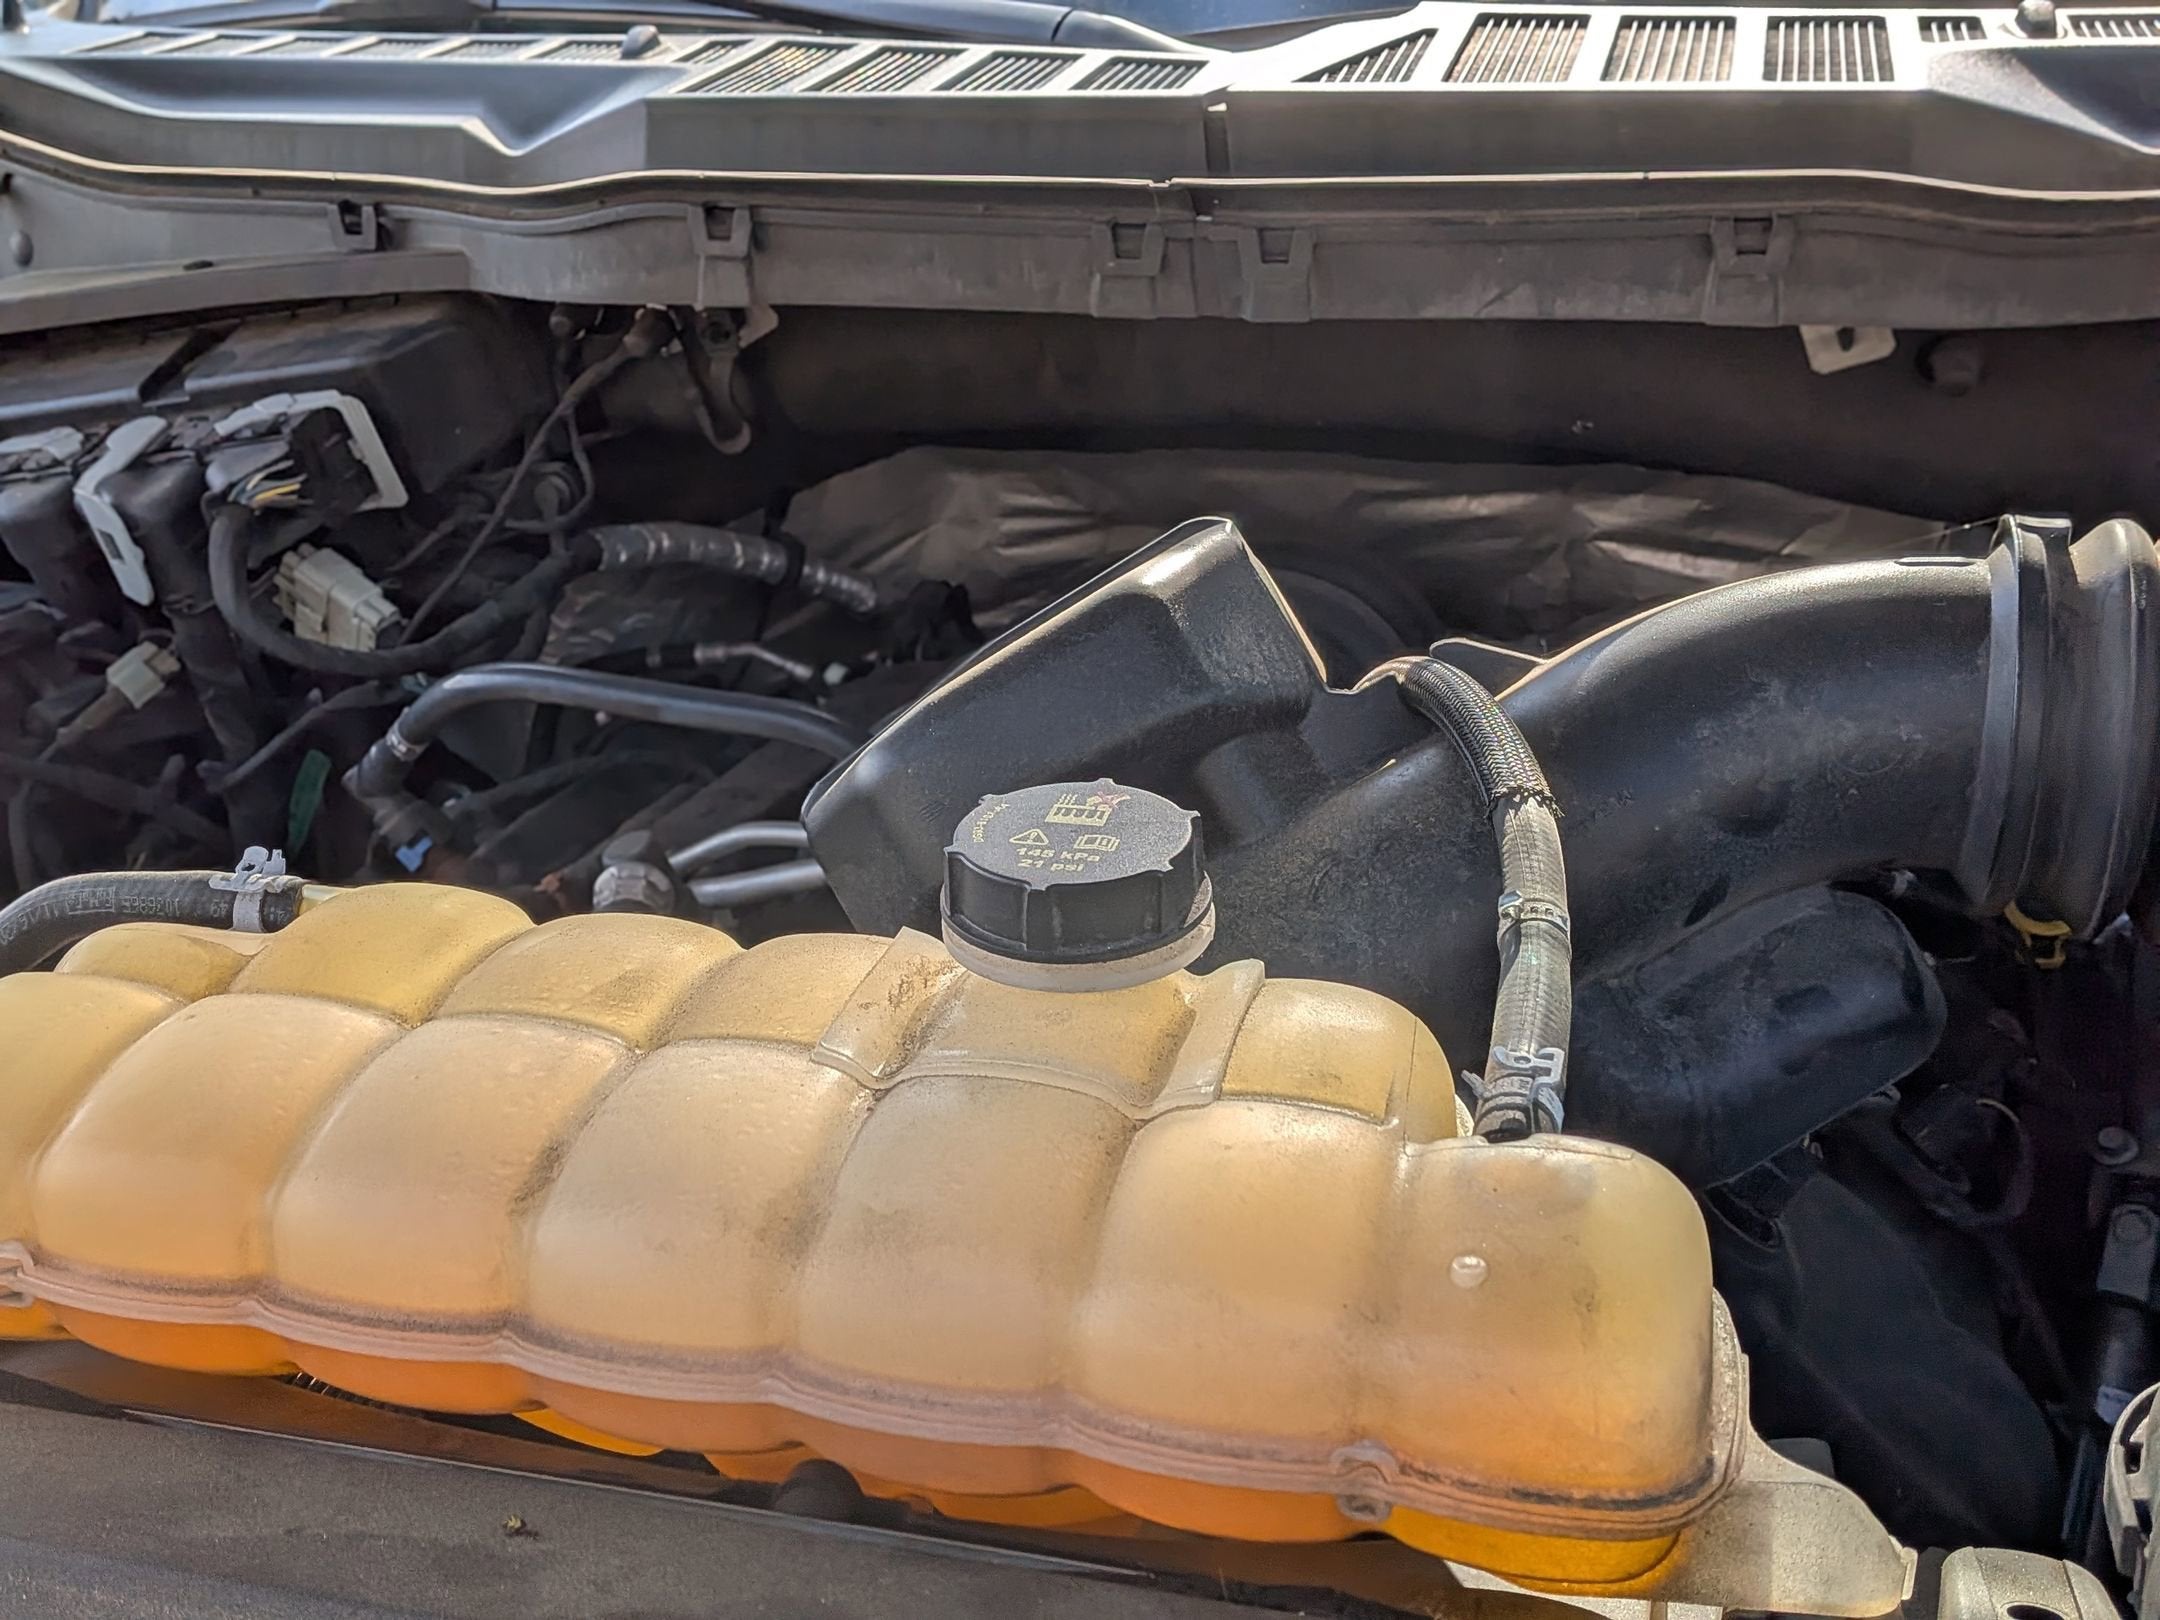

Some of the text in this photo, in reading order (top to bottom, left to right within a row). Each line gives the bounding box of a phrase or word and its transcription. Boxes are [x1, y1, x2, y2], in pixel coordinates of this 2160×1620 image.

[1016, 847, 1100, 862] 145 kPa
[1017, 859, 1084, 872] 21 psi
